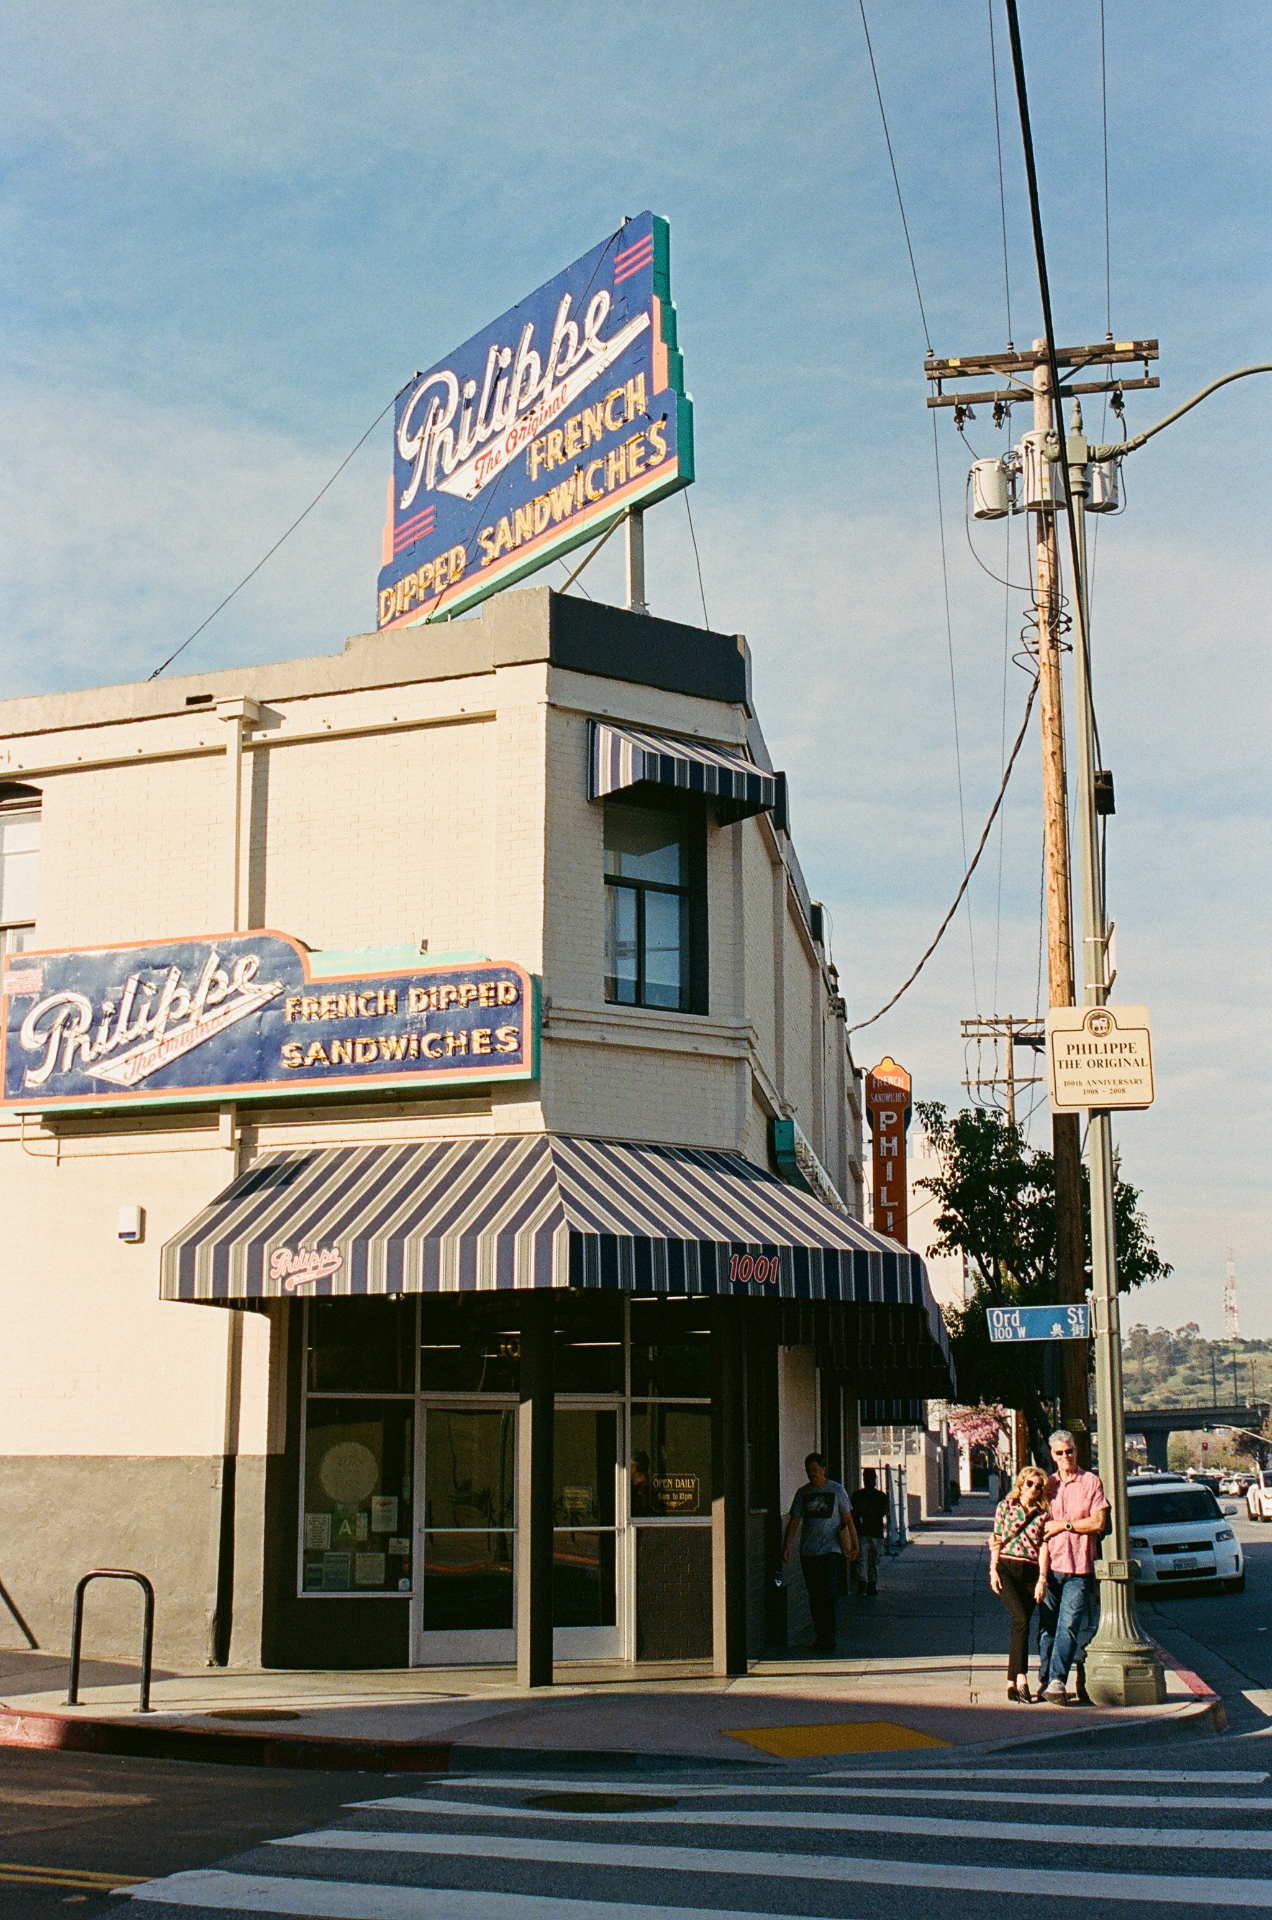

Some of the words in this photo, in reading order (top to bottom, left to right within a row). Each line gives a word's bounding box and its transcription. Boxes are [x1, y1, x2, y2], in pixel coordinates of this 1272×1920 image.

[398, 290, 614, 510] Philippe
[474, 447, 502, 485] The
[505, 383, 568, 455] Original
[528, 372, 648, 482] FRENCH
[378, 545, 466, 626] DIPPED
[478, 419, 668, 567] SANDWICHES
[284, 988, 398, 1023] FRENCH
[408, 980, 519, 1013] DIPPED
[20, 951, 270, 1087] Philippe
[123, 1051, 157, 1080] The
[157, 1005, 231, 1061] Original
[280, 1026, 520, 1069] SANDWICHES
[1066, 1043, 1137, 1056] PHILIPPE
[1057, 1059, 1083, 1070] THE
[1087, 1057, 1148, 1069] ORIGINAL
[870, 1092, 907, 1103] SANDWICHES
[872, 1075, 904, 1089] FRENCH
[1086, 1078, 1144, 1087] ANNIVERSARY
[1109, 1087, 1126, 1095] 2008
[879, 1111, 899, 1244] PHILI
[270, 1247, 341, 1279] Philippe
[730, 1253, 779, 1284] 1001
[992, 1310, 1020, 1328] Ord
[1067, 1307, 1085, 1324] St
[994, 1327, 1013, 1340] 100
[1017, 1326, 1027, 1339] W
[653, 1479, 673, 1489] OPEN
[675, 1478, 696, 1489] DAILY
[338, 1519, 352, 1535] A
